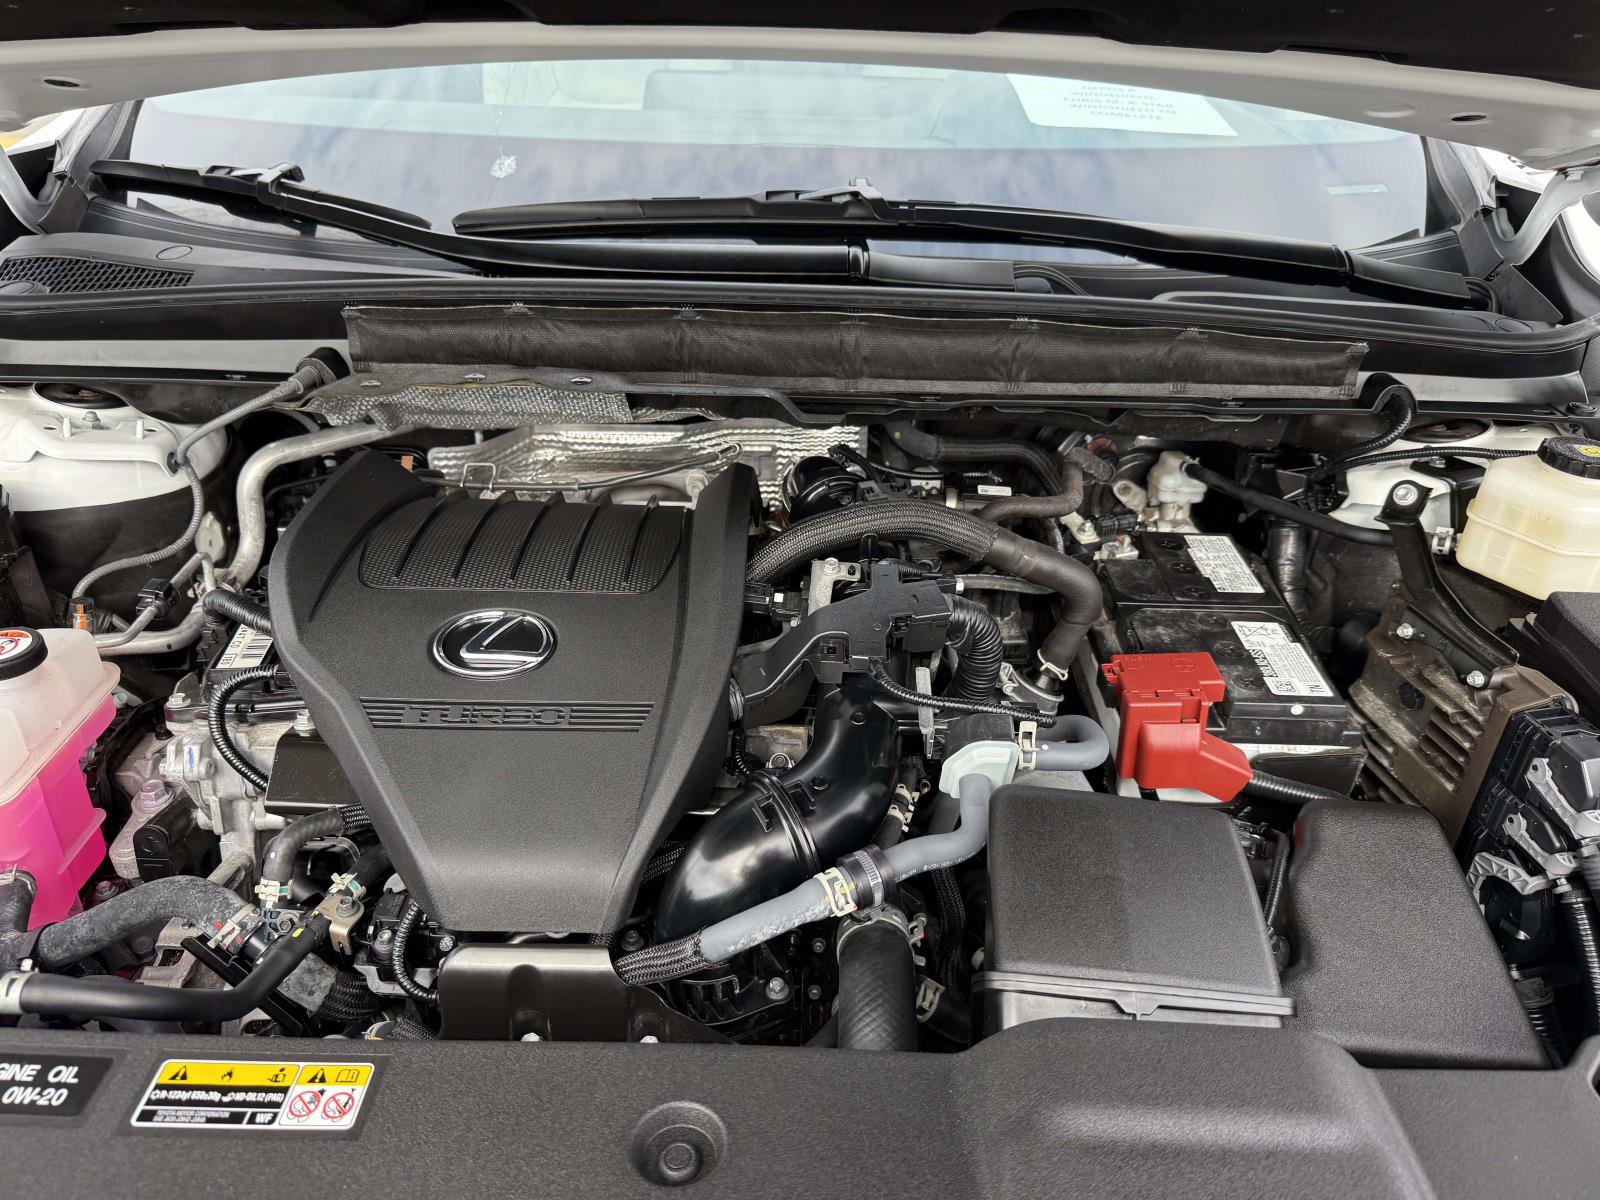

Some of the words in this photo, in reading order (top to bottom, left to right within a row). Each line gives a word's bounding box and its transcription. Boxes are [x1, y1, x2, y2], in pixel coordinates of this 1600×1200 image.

[405, 703, 571, 726] TURBO
[47, 1065, 79, 1083] OIL
[2, 1086, 69, 1107] 0W-20
[255, 1112, 274, 1124] WF
